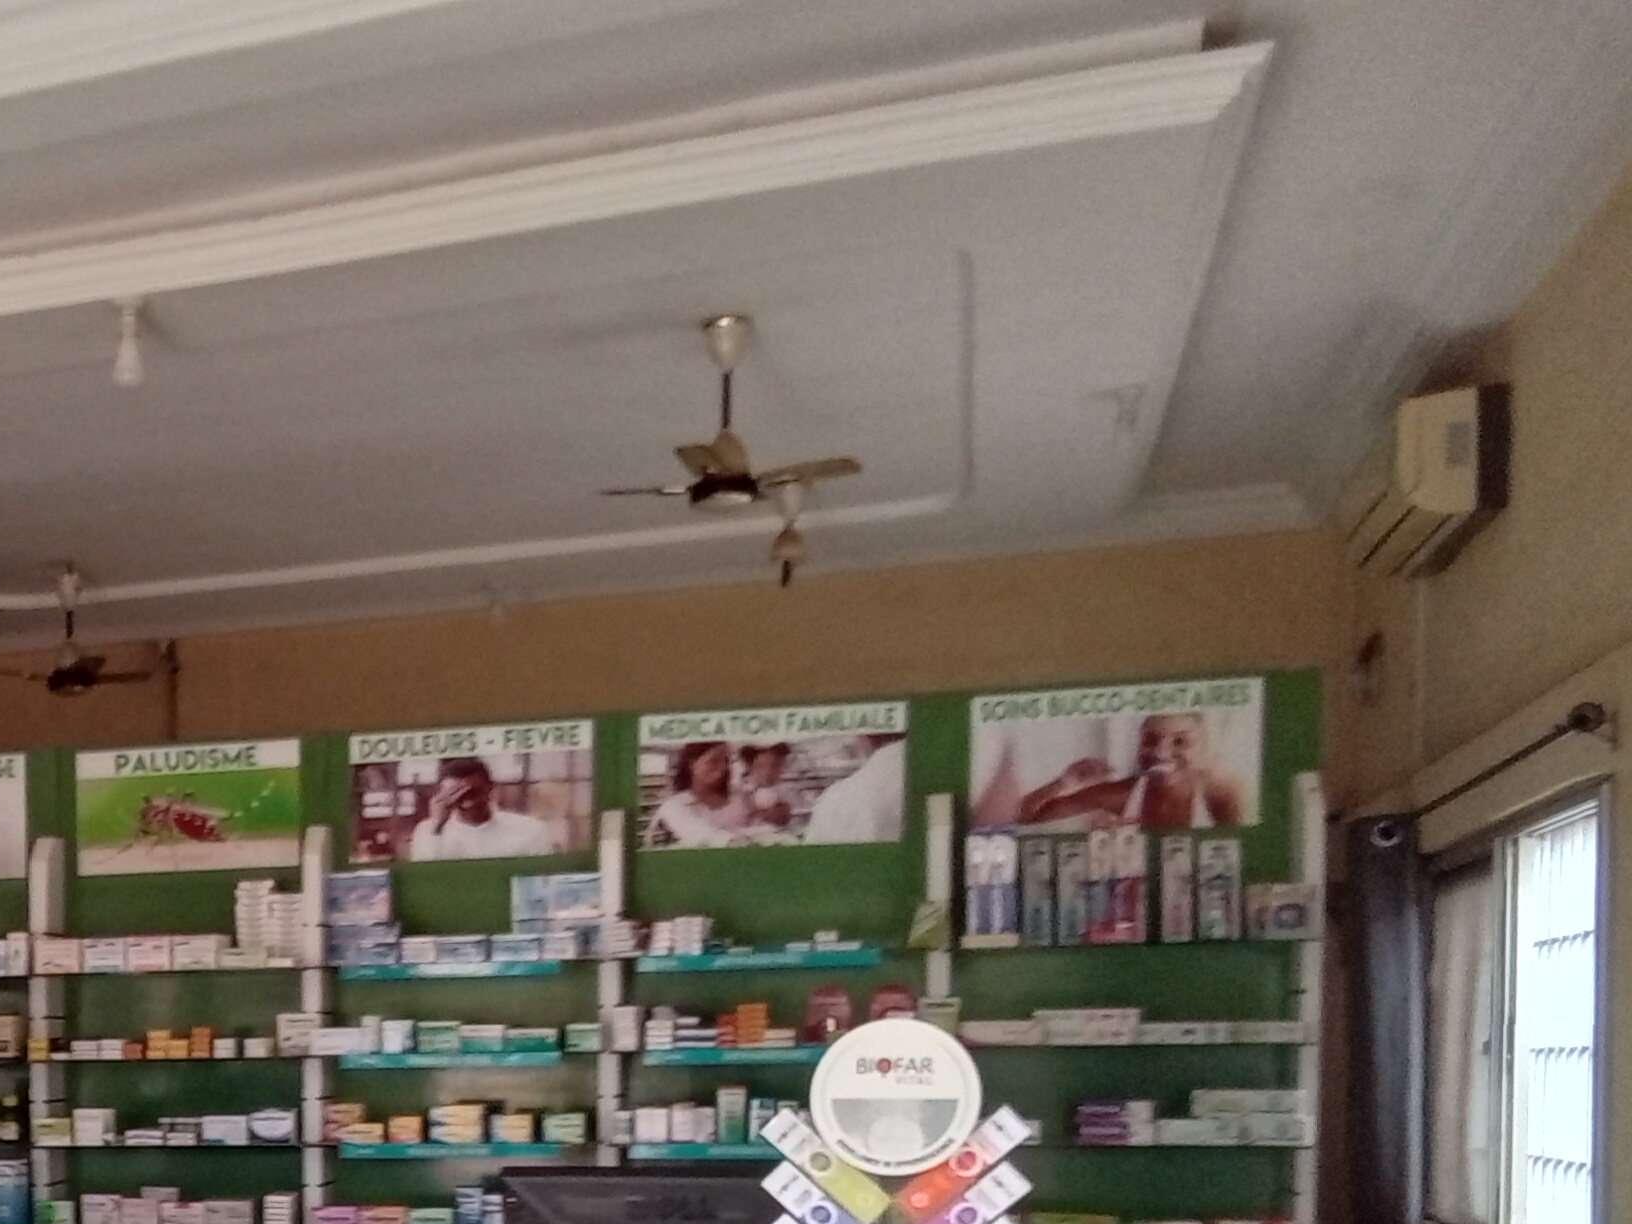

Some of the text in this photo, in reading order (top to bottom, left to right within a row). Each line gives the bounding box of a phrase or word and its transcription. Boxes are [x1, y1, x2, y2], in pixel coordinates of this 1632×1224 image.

[979, 697, 1043, 722] SOINS
[356, 727, 477, 760] DOULEURS
[501, 723, 582, 751] FIEVRE
[114, 746, 259, 775] PALUDISME
[855, 1057, 935, 1076] BIOFAR
